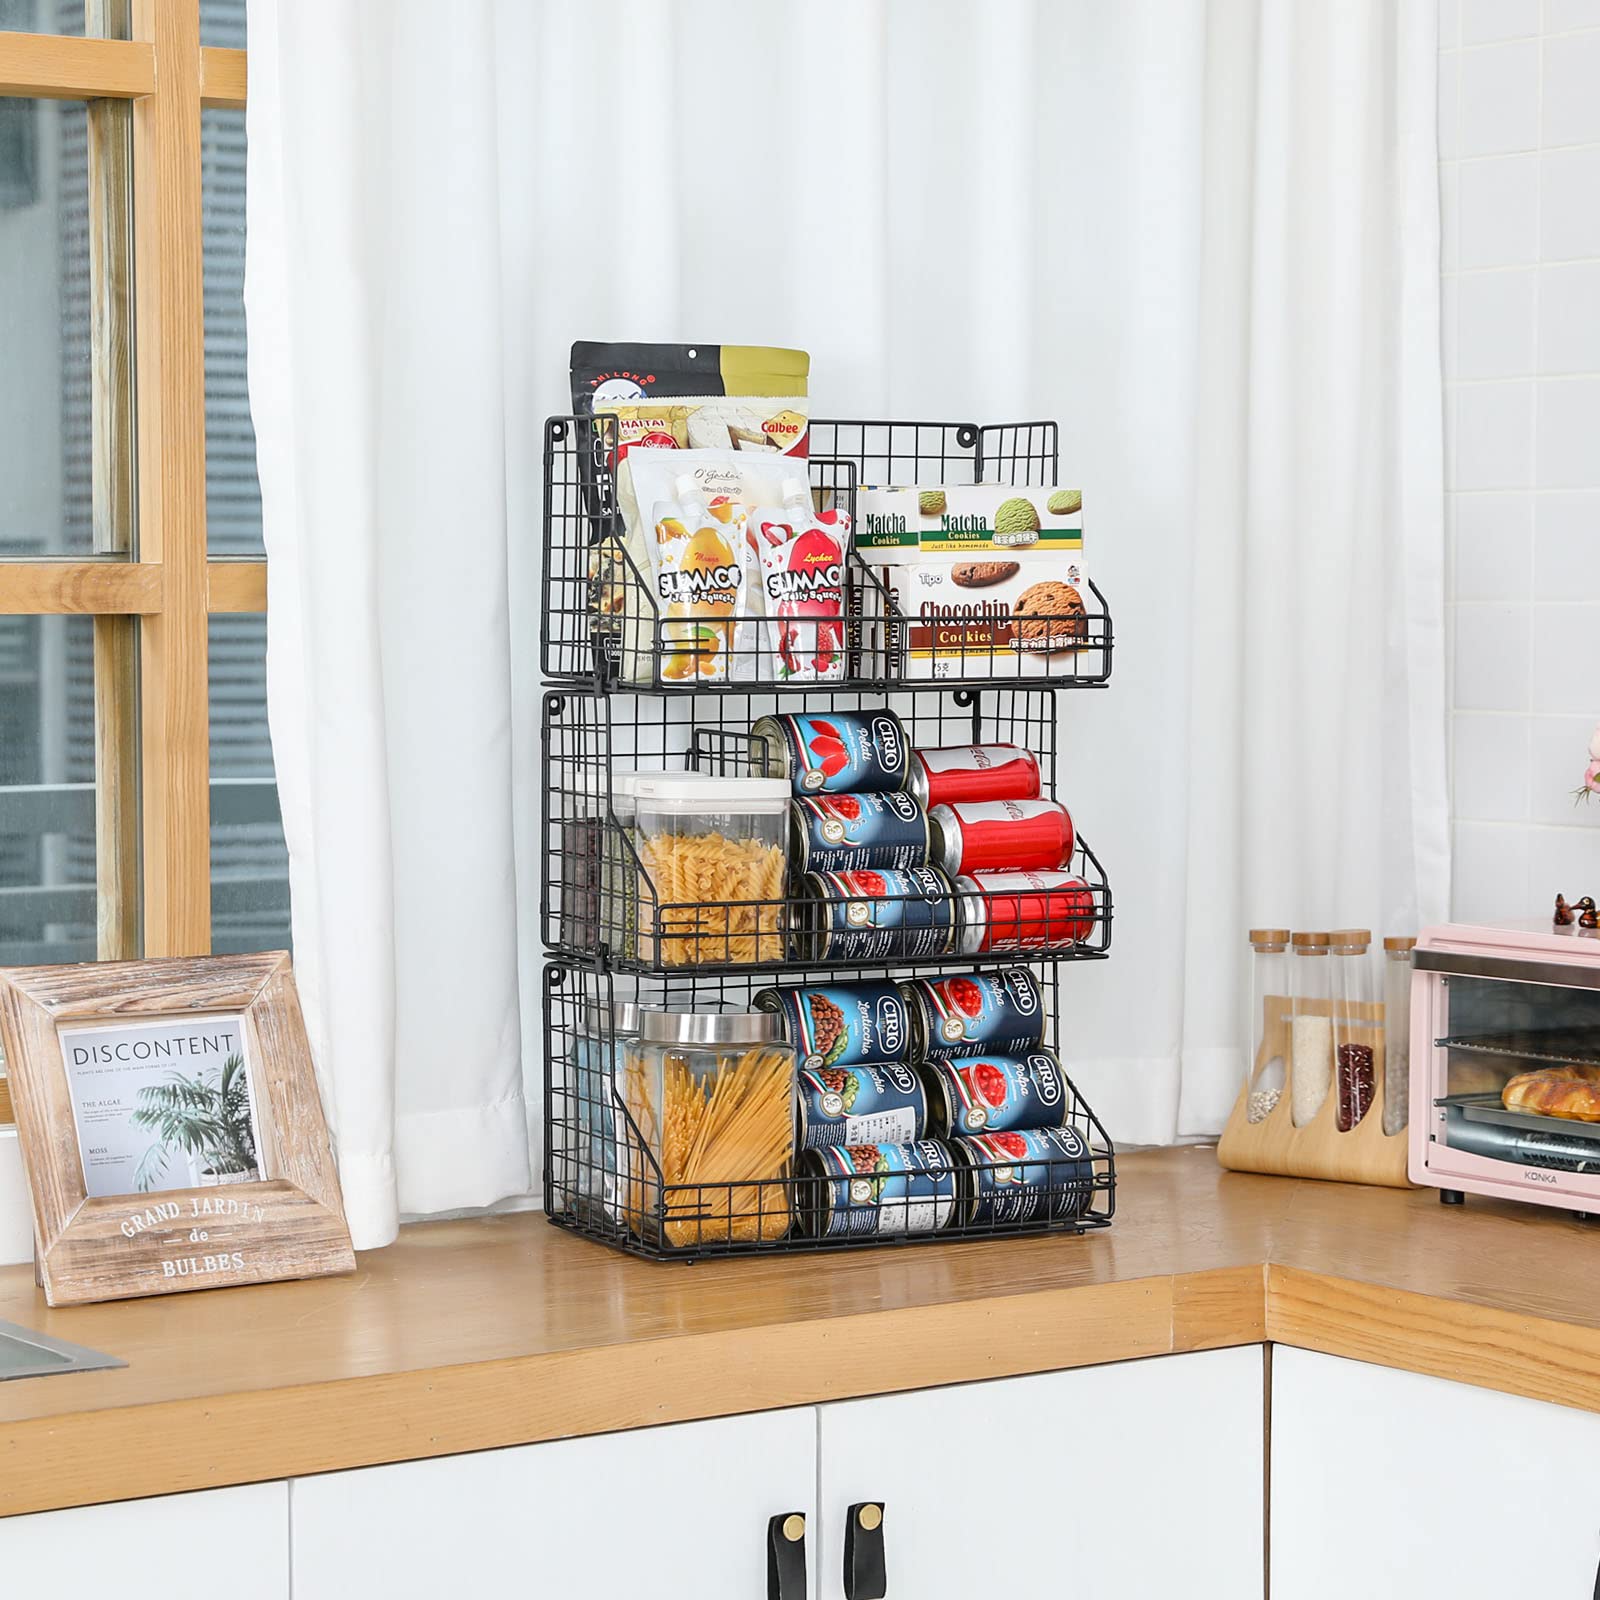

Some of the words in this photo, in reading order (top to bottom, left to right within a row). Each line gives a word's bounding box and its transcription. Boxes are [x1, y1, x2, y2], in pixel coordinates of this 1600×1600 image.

[613, 371, 648, 386] LONG
[620, 419, 665, 430] HAITAI
[761, 421, 799, 434] Calbee
[865, 512, 906, 535] Matcha
[941, 514, 987, 532] Matcha
[871, 535, 900, 546] Cookies
[948, 531, 980, 540] Cookies
[803, 552, 834, 564] Lychee
[658, 564, 743, 598] SUMACO
[767, 564, 842, 598] SUMAC
[919, 573, 943, 587] Tipo
[699, 590, 736, 606] Squeeze
[919, 599, 1010, 629] Chocochip
[939, 631, 993, 643] Cookies
[857, 727, 873, 762] Pelati
[878, 721, 898, 767] CIRIO
[892, 792, 913, 816] IRIO
[987, 976, 1005, 1008] Polpa
[1008, 971, 1034, 1010] CIRIO
[857, 1000, 876, 1056] Lenticchie
[883, 1001, 899, 1049] CIRIO
[73, 1034, 233, 1065] DISCONTENT
[888, 1064, 912, 1088] IRIO
[1013, 1063, 1030, 1097] Polpa
[1034, 1057, 1057, 1100] CIRIO
[1524, 1171, 1558, 1184] KONKA
[120, 1201, 180, 1238] GRAND
[189, 1197, 265, 1224] JARDIN
[189, 1228, 209, 1242] de
[160, 1252, 245, 1278] BULBES
